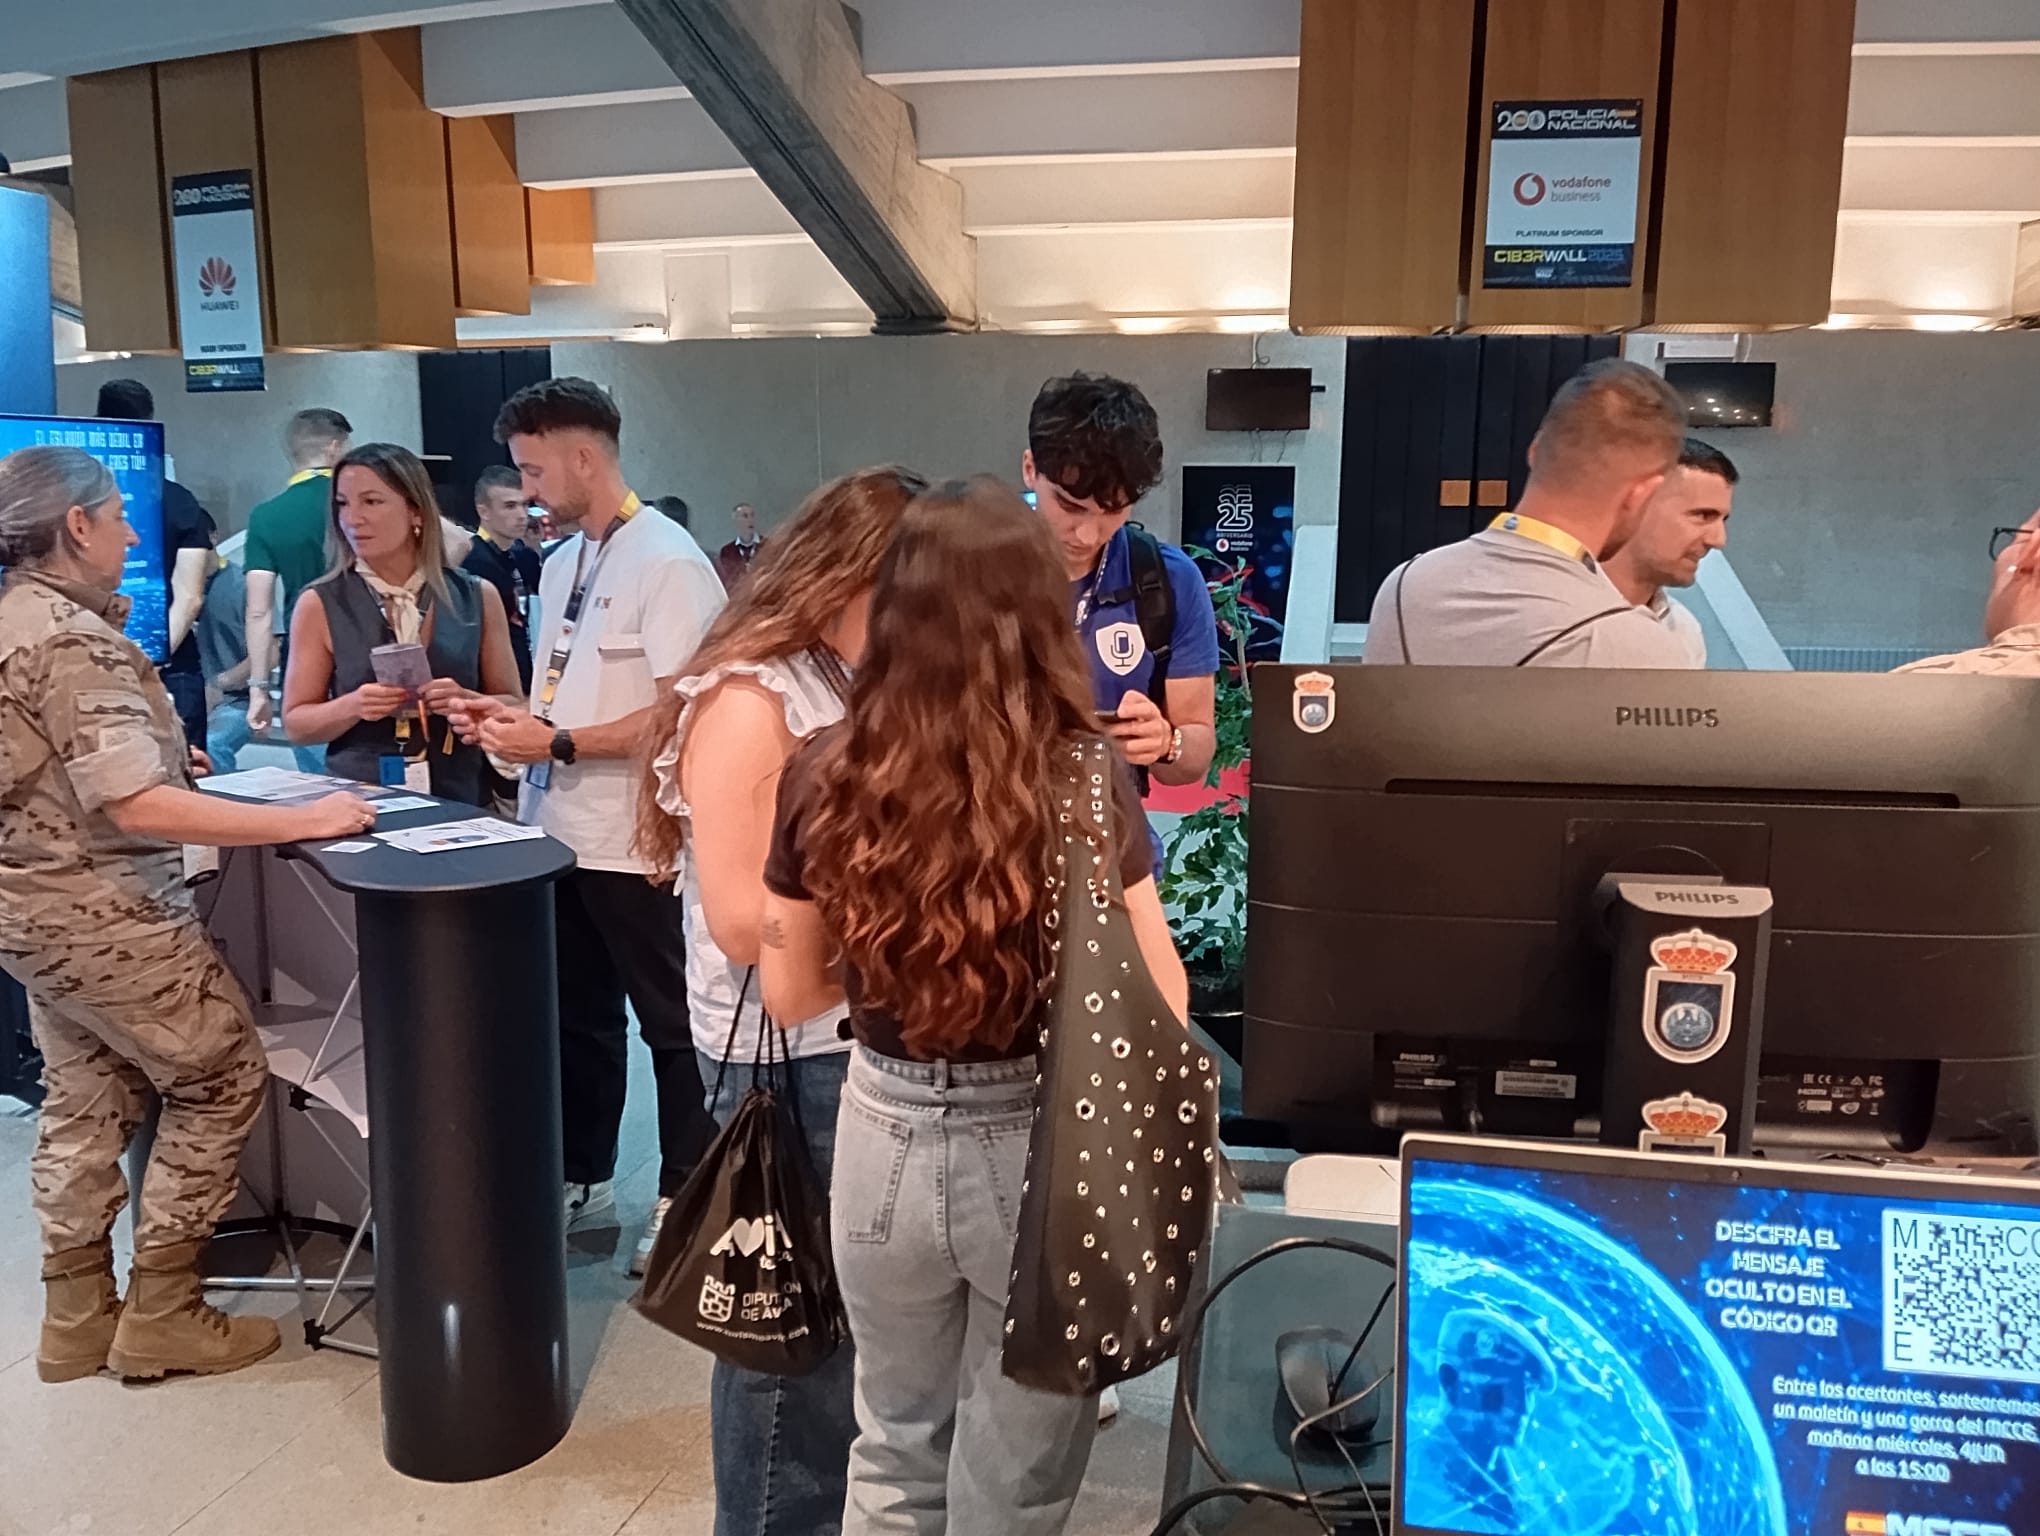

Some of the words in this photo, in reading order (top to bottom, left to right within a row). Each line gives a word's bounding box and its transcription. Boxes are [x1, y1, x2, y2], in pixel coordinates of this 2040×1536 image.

[1547, 119, 1637, 130] NACIONAL
[1552, 176, 1612, 188] vodafone
[1551, 191, 1601, 202] business
[1516, 229, 1560, 237] PLATINUM
[1561, 229, 1603, 237] SPONSOR
[200, 300, 240, 312] HUAWEI
[1216, 503, 1253, 532] 25
[1616, 706, 1719, 728] PHILIPS
[1655, 891, 1740, 905] PHILIPS
[1400, 1053, 1436, 1062] PHILIPS
[1715, 1219, 1813, 1248] DESCIFRA
[1814, 1227, 1842, 1251] EL
[1732, 1250, 1825, 1278] MENSAJE
[1705, 1277, 1796, 1304] OCULTO
[1797, 1284, 1825, 1306] EN
[1826, 1287, 1853, 1309] EL
[1720, 1305, 1804, 1334] CÓDIGO
[1805, 1314, 1838, 1337] QR
[1772, 1374, 1818, 1397] Entre
[1819, 1379, 1845, 1399] los
[1772, 1401, 1796, 1419] un
[1797, 1402, 1859, 1424] maletín
[1861, 1411, 1874, 1430] y
[1875, 1411, 1906, 1429] una
[1909, 1414, 1954, 1434] gorra
[1956, 1416, 1984, 1436] del
[1806, 1427, 1874, 1450] mañana
[1854, 1457, 1870, 1475] a
[1898, 1459, 1950, 1483] 15:00
